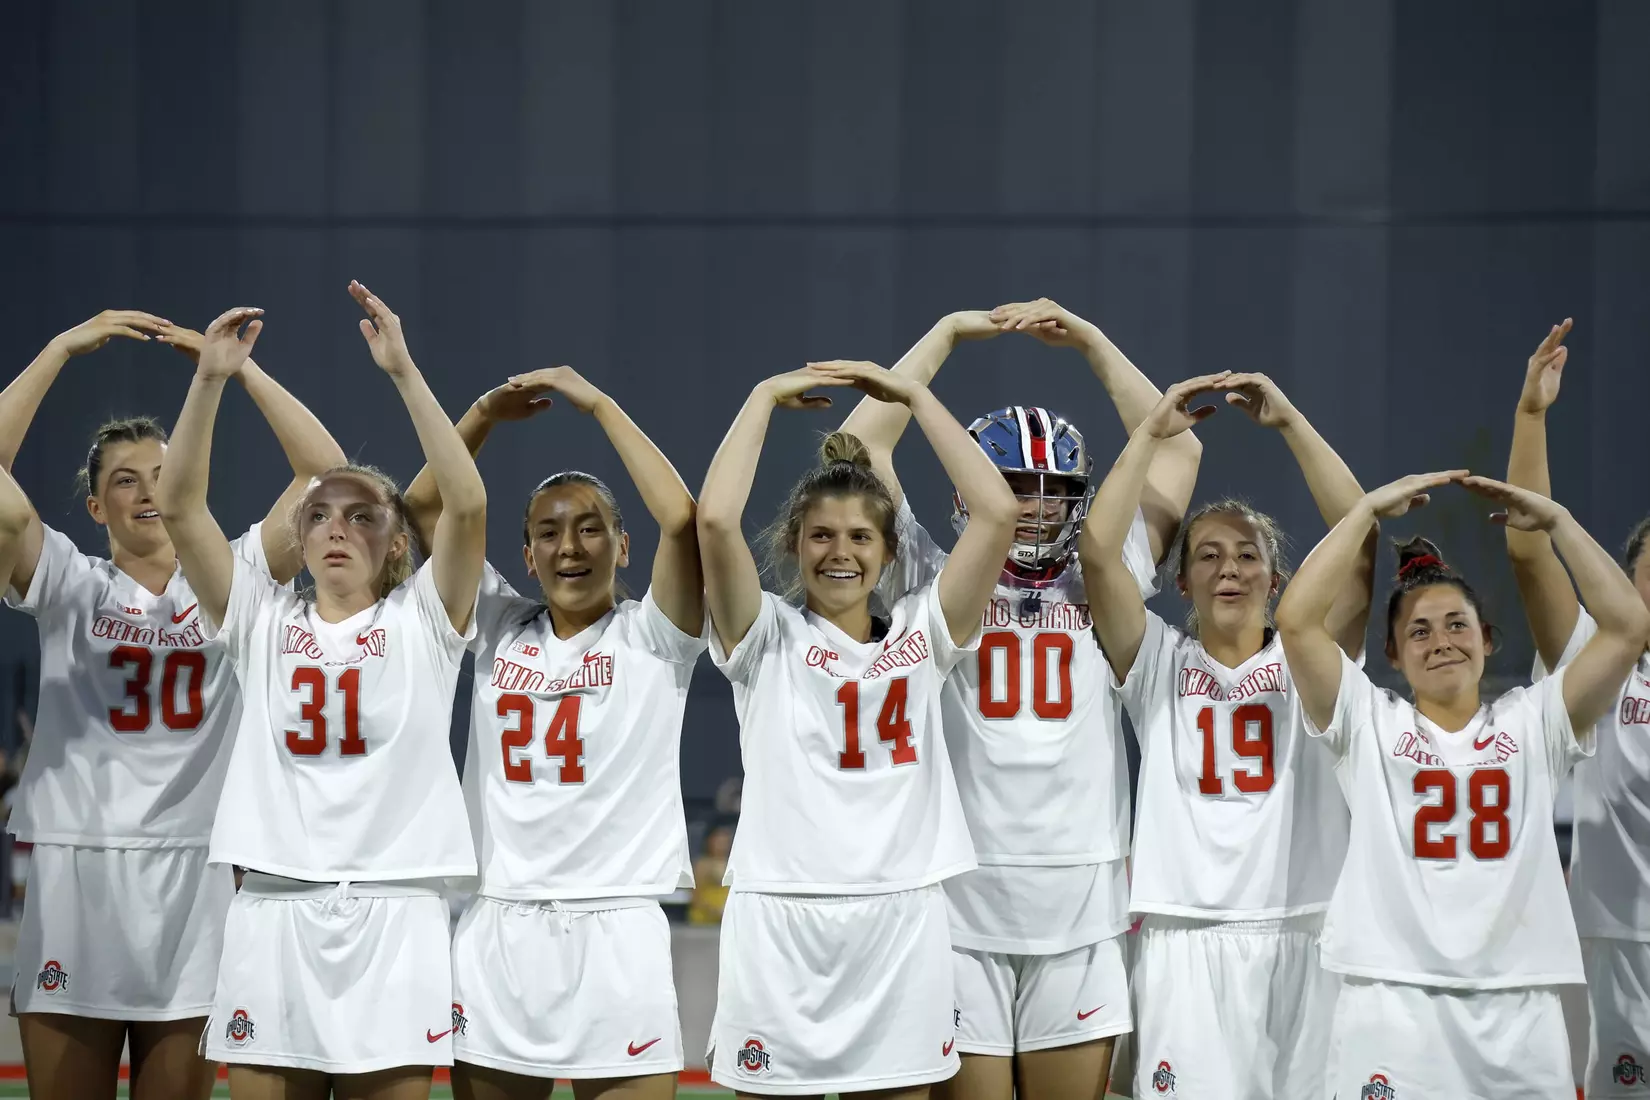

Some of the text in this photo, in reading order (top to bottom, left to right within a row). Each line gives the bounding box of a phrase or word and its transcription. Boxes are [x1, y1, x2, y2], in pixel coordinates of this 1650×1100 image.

[1017, 550, 1035, 558] STX
[107, 644, 207, 734] 30
[862, 629, 929, 680] STATE
[976, 629, 1076, 722] 00
[1178, 667, 1224, 702] OHIO
[283, 664, 369, 759] 31
[496, 691, 587, 786] 24
[834, 675, 920, 772] 14
[1196, 702, 1277, 798] 19
[1411, 766, 1512, 862] 28
[48, 967, 69, 991] STATE
[236, 1016, 255, 1040] STATE
[750, 1046, 771, 1071] STATE
[1160, 1068, 1177, 1092] STATE
